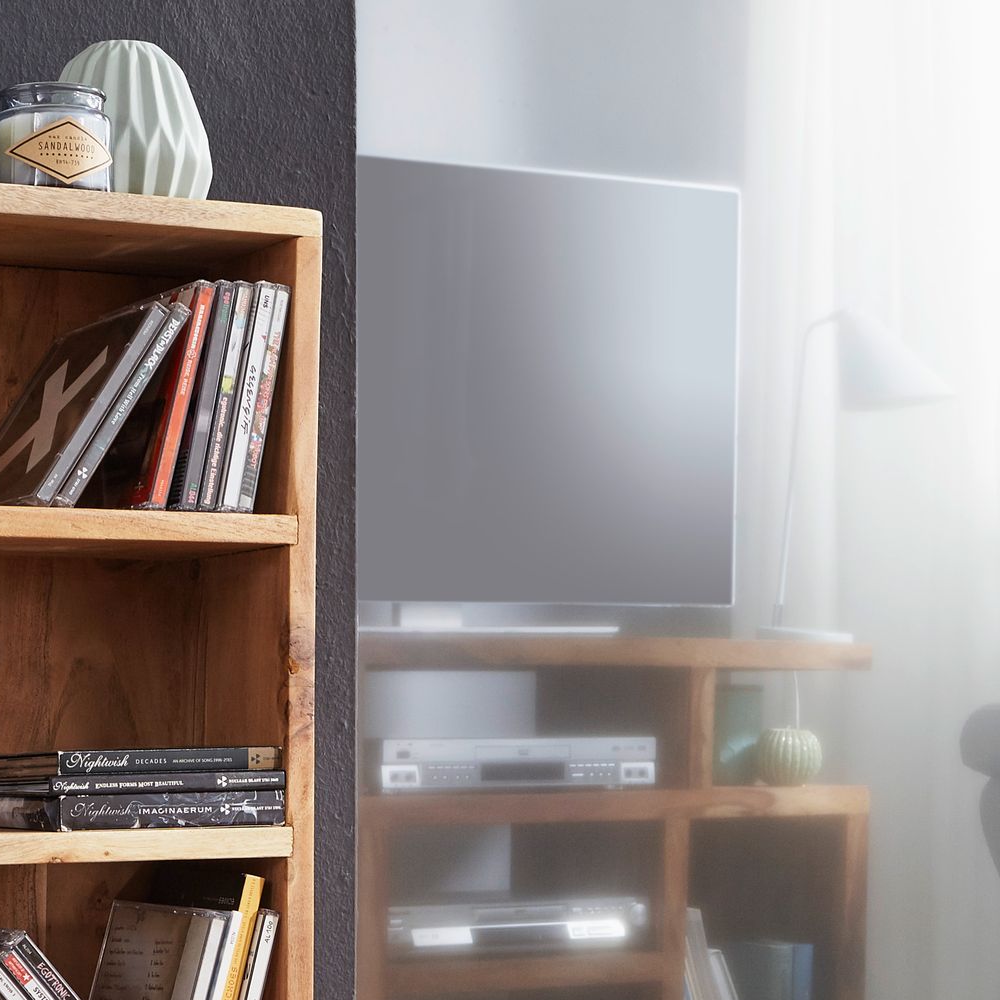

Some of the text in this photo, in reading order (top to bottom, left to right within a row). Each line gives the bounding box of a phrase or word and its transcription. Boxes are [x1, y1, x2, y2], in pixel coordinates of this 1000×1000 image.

[38, 141, 96, 154] SANDALWOOD
[262, 294, 270, 309] UNS
[203, 468, 217, 505] Einstellung
[65, 752, 130, 773] Nightwish
[53, 781, 90, 793] Nightwish
[70, 801, 213, 822] Nightwish IMAGINAERUM
